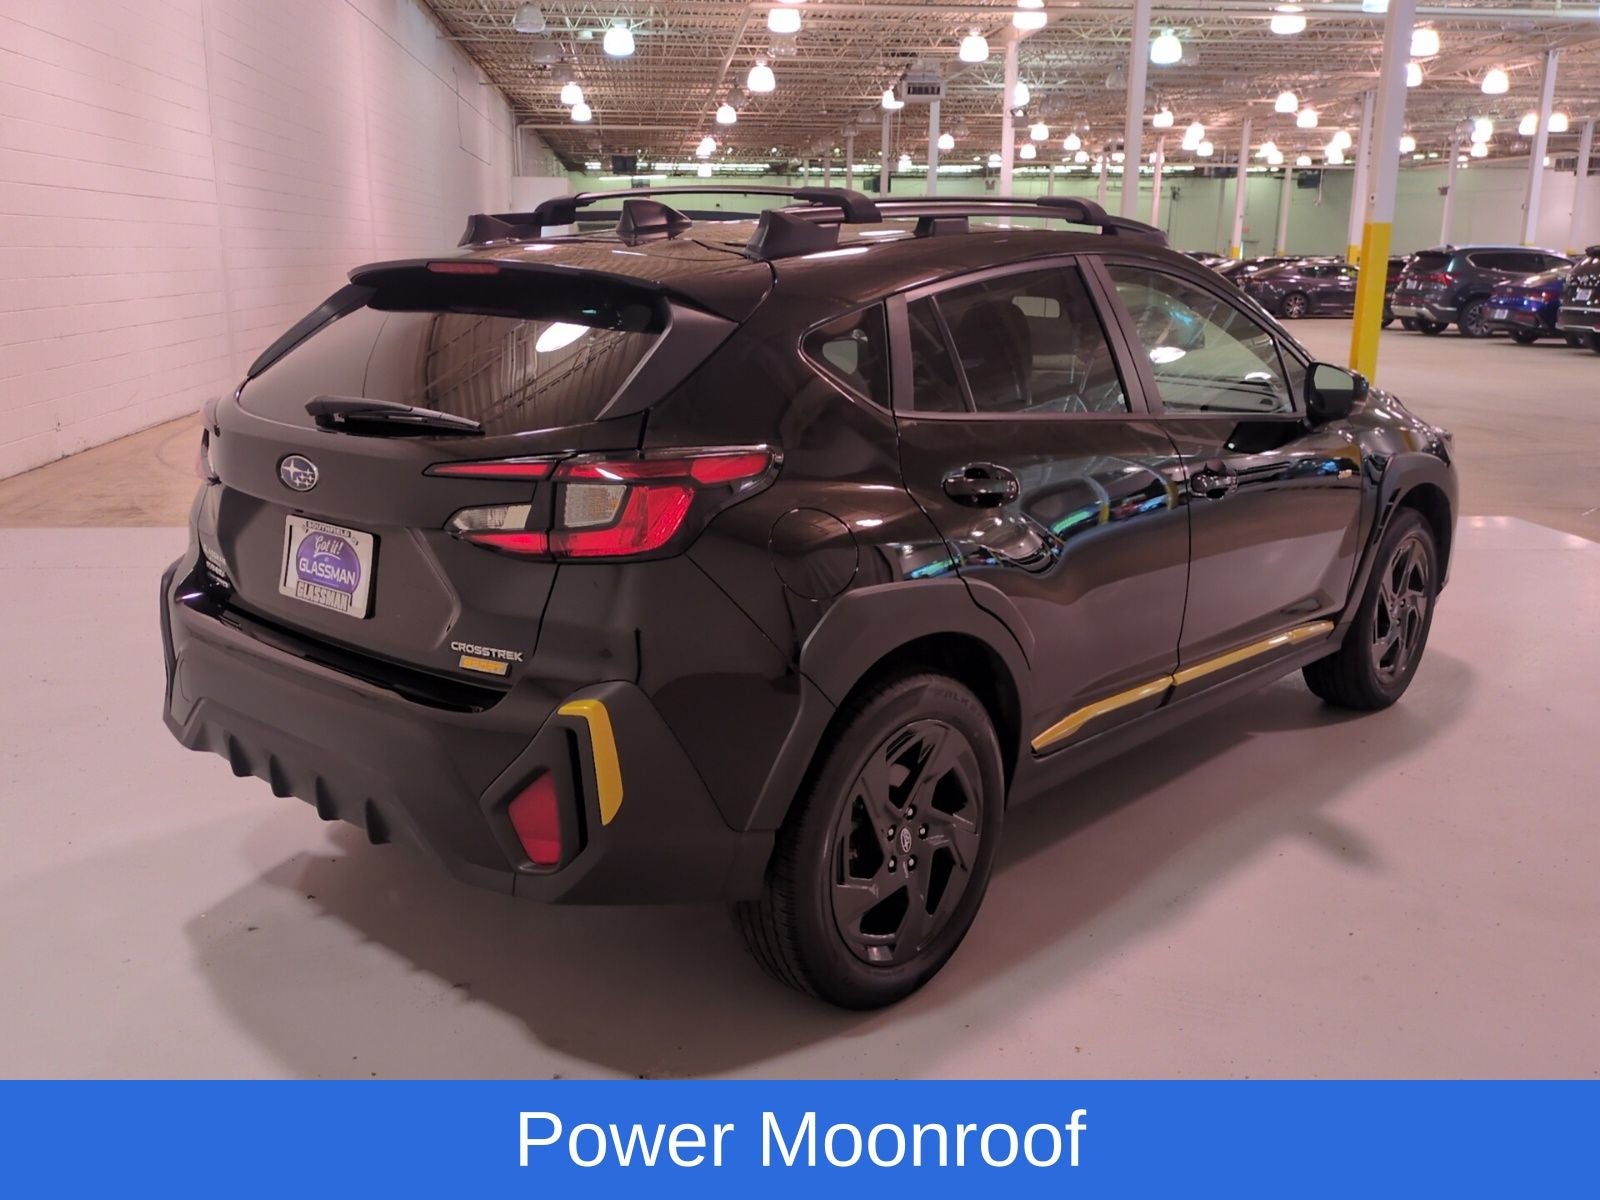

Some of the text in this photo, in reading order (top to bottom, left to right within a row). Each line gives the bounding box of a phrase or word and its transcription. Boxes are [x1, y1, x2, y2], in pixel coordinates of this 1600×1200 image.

[314, 536, 344, 555] Got it!
[299, 557, 356, 586] GLASSMAN
[297, 582, 349, 612] GLASSMAN
[450, 641, 523, 662] CROSSTREK
